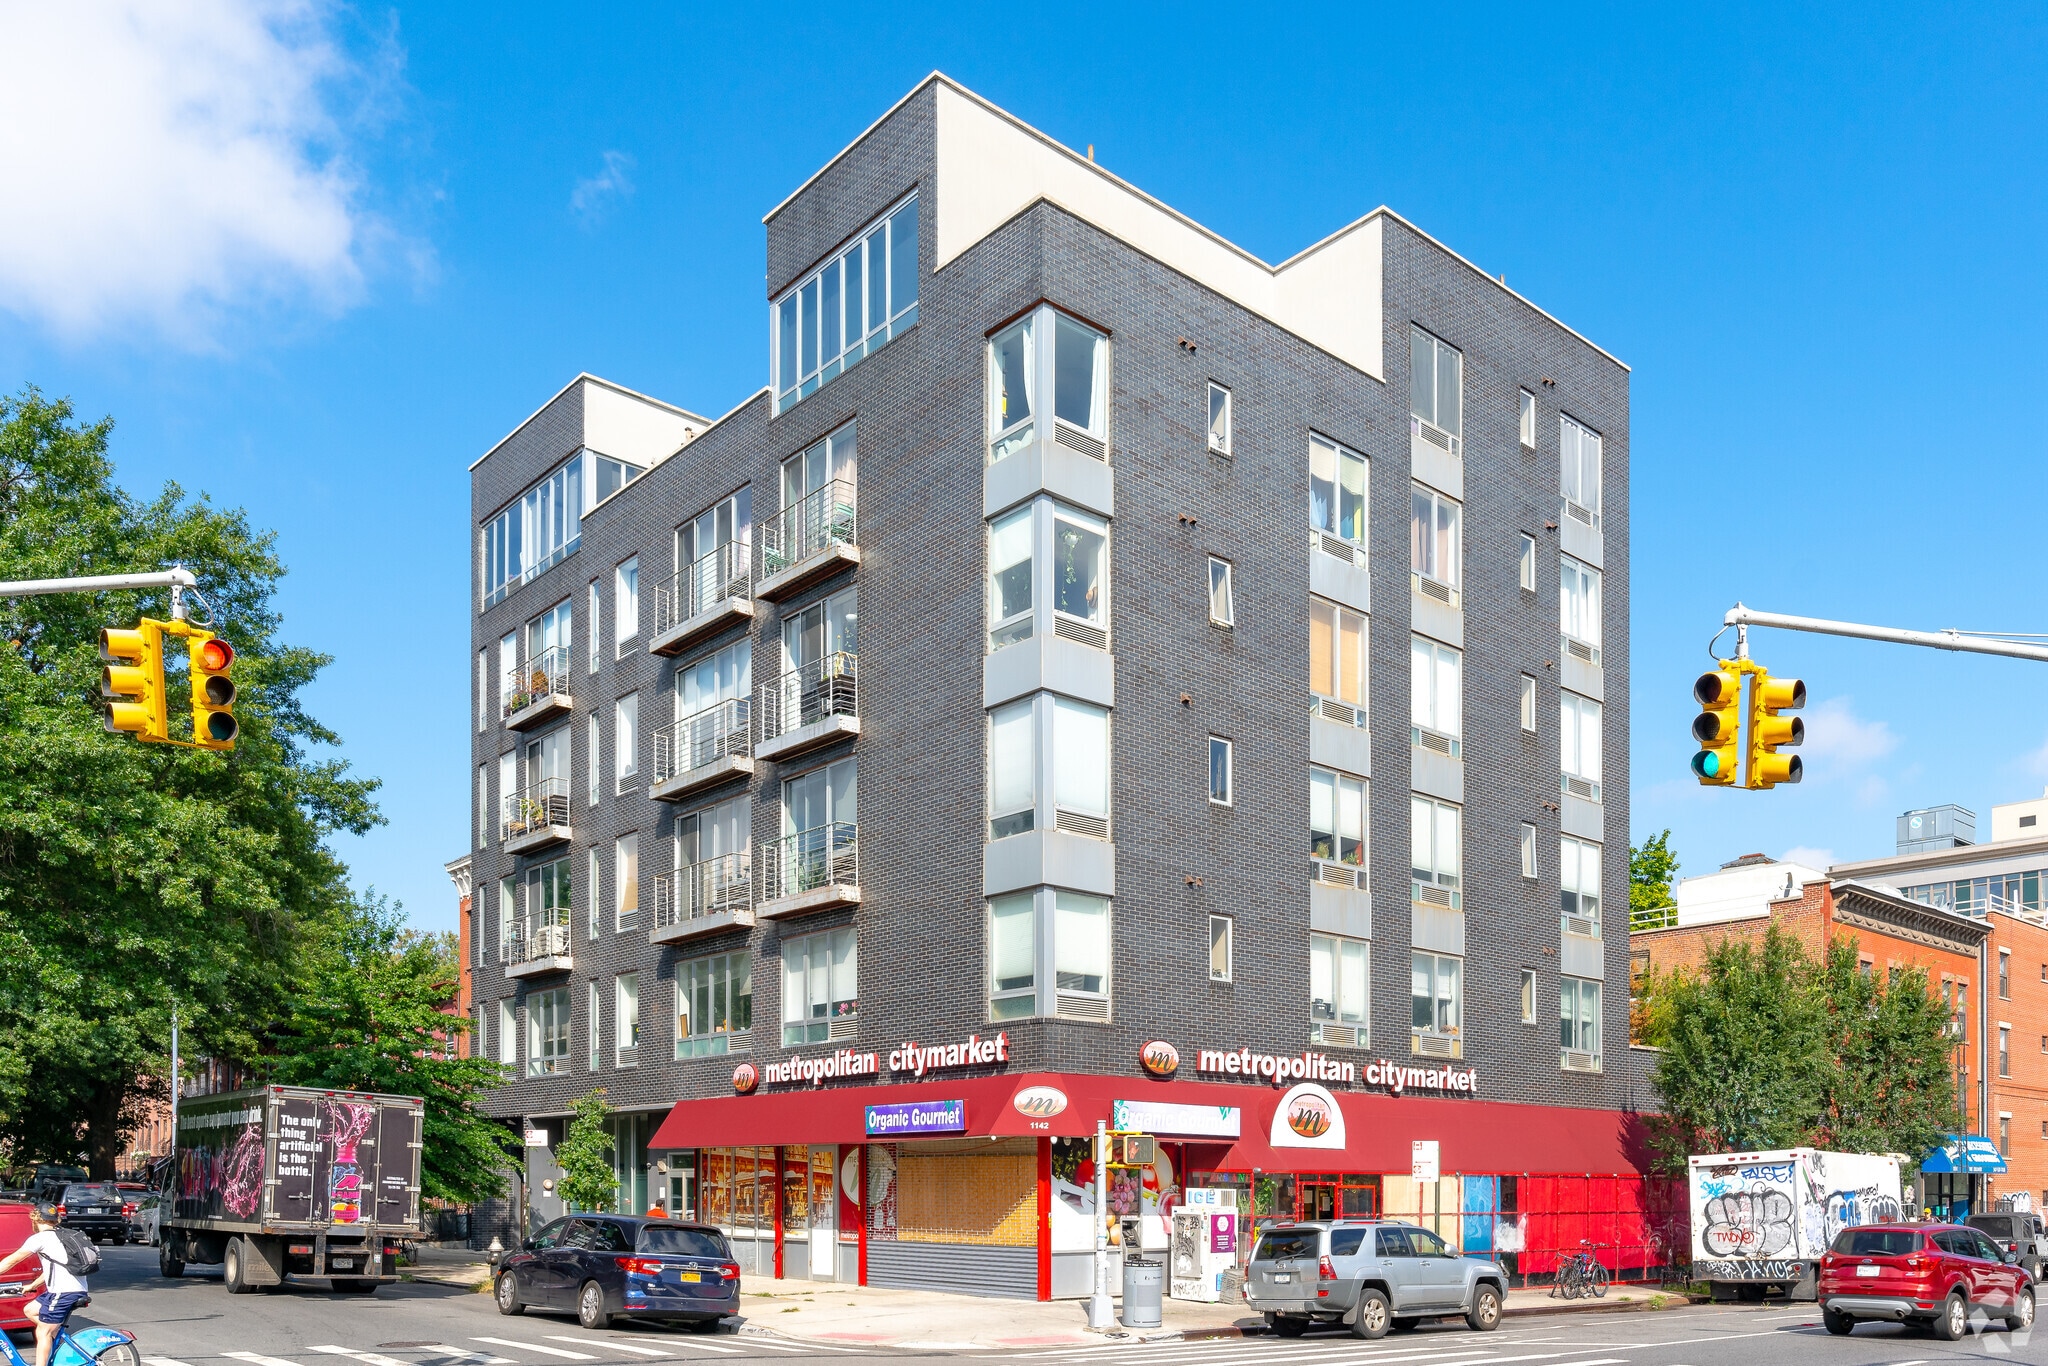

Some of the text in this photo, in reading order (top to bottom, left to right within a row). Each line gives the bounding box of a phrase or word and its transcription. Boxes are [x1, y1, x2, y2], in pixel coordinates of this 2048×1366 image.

[766, 1032, 1007, 1085] metropolitan citymarket
[1198, 1047, 1477, 1092] metropolitan citymarket
[281, 1115, 321, 1129] The only
[868, 1107, 960, 1131] Organic Gourmet
[1118, 1106, 1236, 1129] Organic Gourmet
[1029, 1122, 1049, 1130] 1142
[281, 1127, 306, 1140] thing
[280, 1141, 323, 1152] artificial
[279, 1152, 307, 1164] is the
[279, 1165, 312, 1176] bottle.
[1188, 1190, 1215, 1204] ICE
